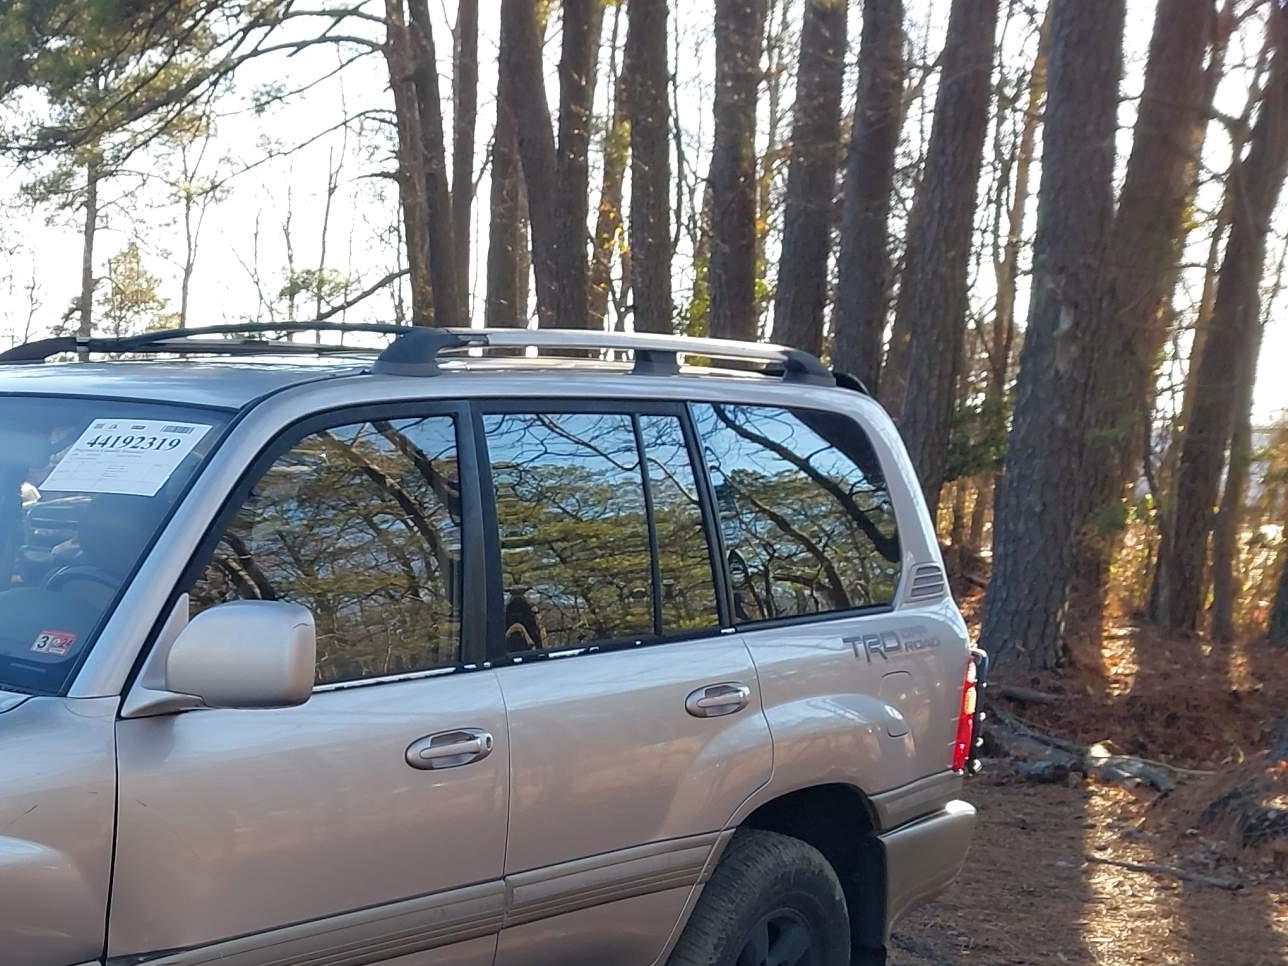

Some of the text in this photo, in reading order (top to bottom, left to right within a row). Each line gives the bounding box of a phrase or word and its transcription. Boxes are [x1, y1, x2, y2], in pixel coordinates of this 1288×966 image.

[87, 433, 181, 452] 44192319
[37, 635, 50, 649] 3
[843, 632, 901, 662] TRD
